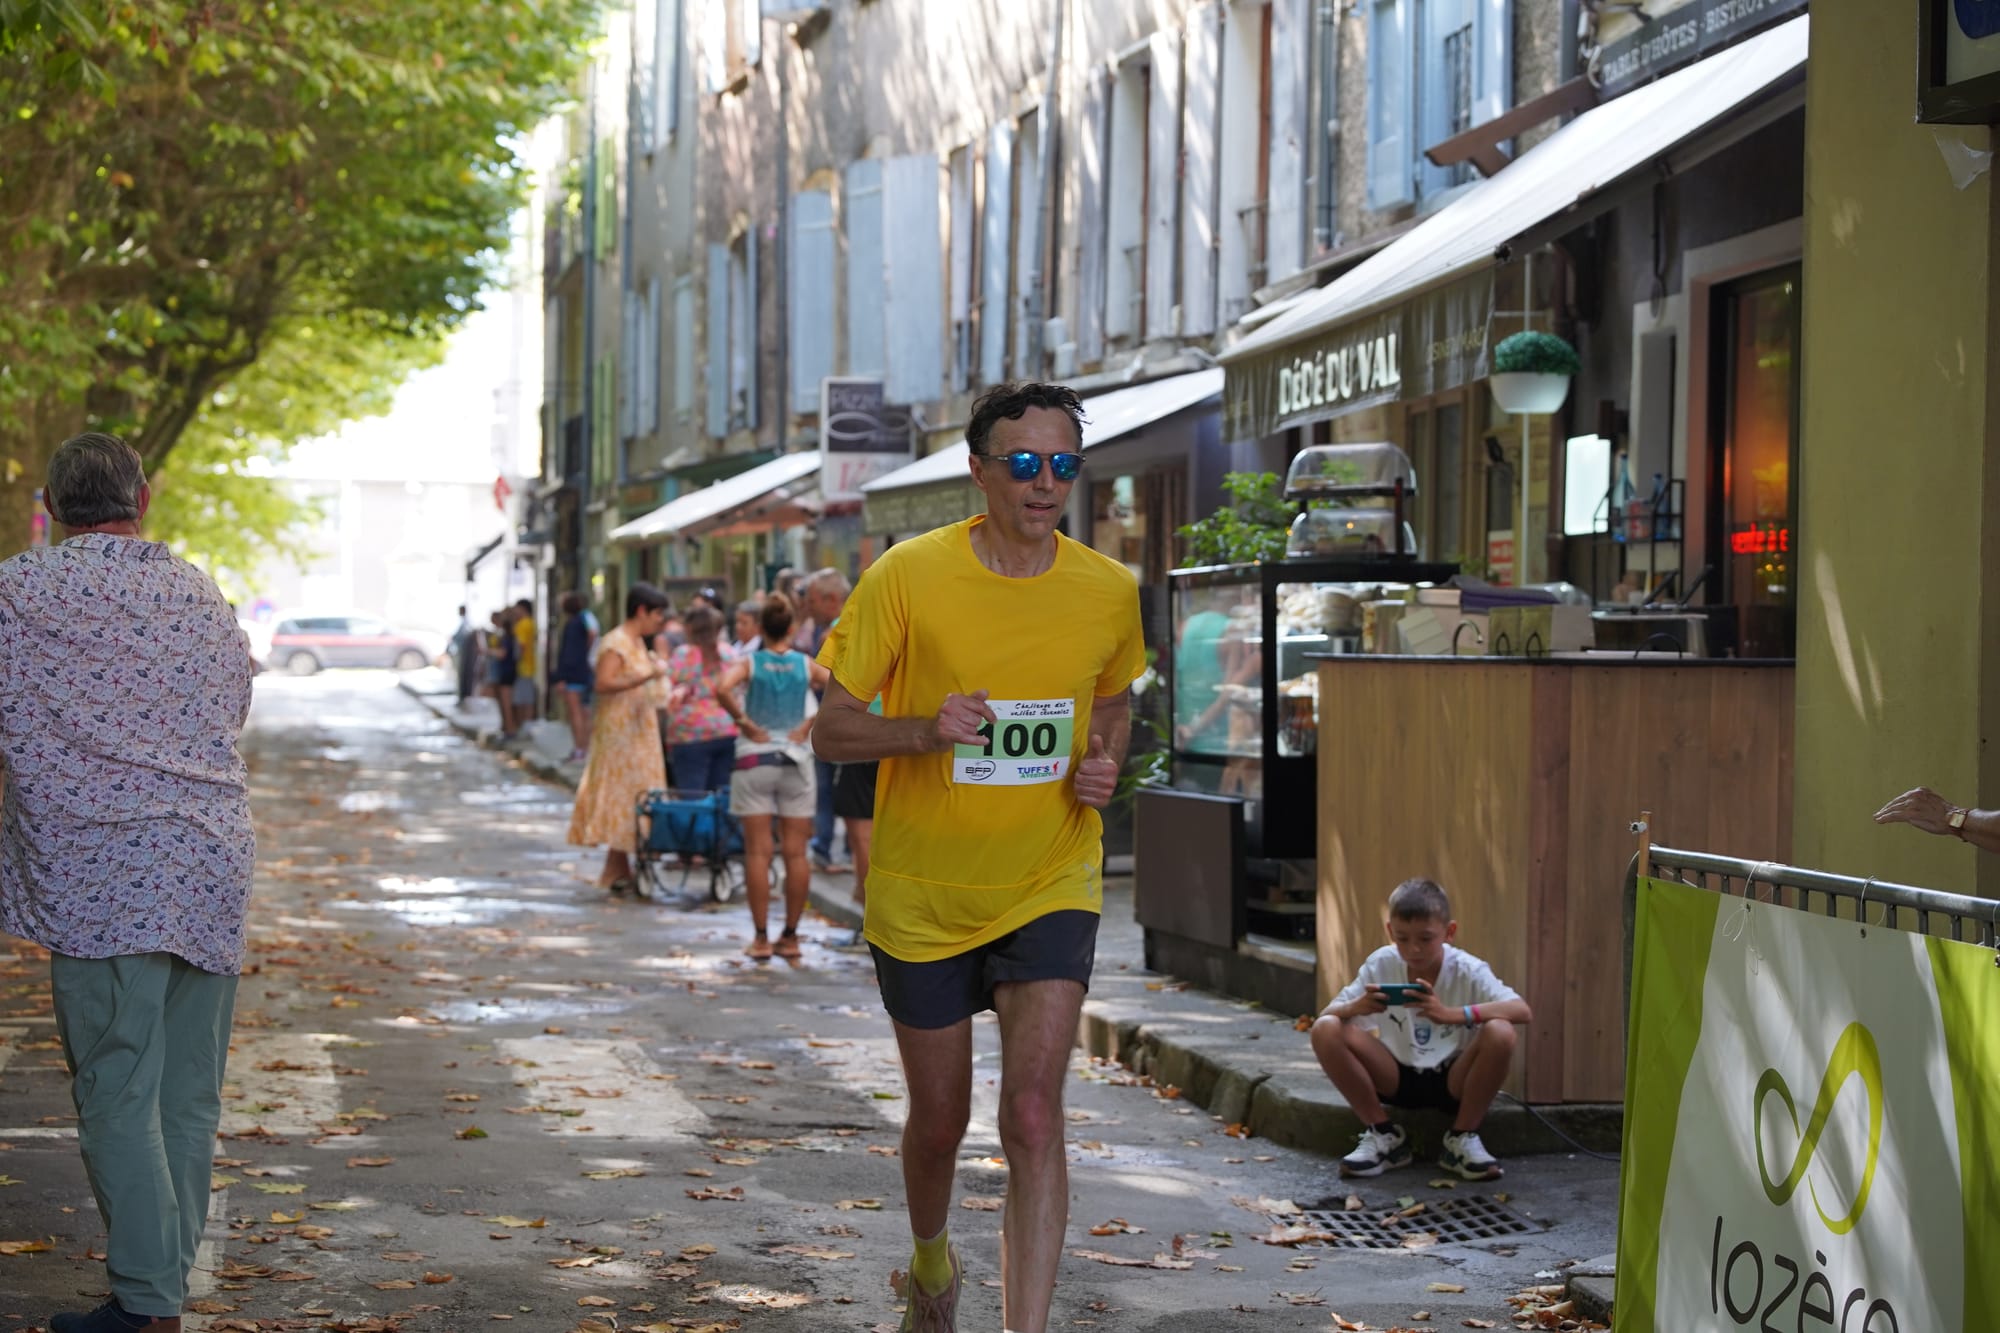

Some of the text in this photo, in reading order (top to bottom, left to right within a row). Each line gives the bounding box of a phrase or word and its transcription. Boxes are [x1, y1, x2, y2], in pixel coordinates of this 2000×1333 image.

[1278, 349, 1325, 416] DÉDÉ
[1325, 345, 1354, 401] DU
[1356, 332, 1401, 393] VAL
[1015, 702, 1051, 712] Challenge
[976, 722, 1058, 758] 100
[965, 766, 992, 775] BFP
